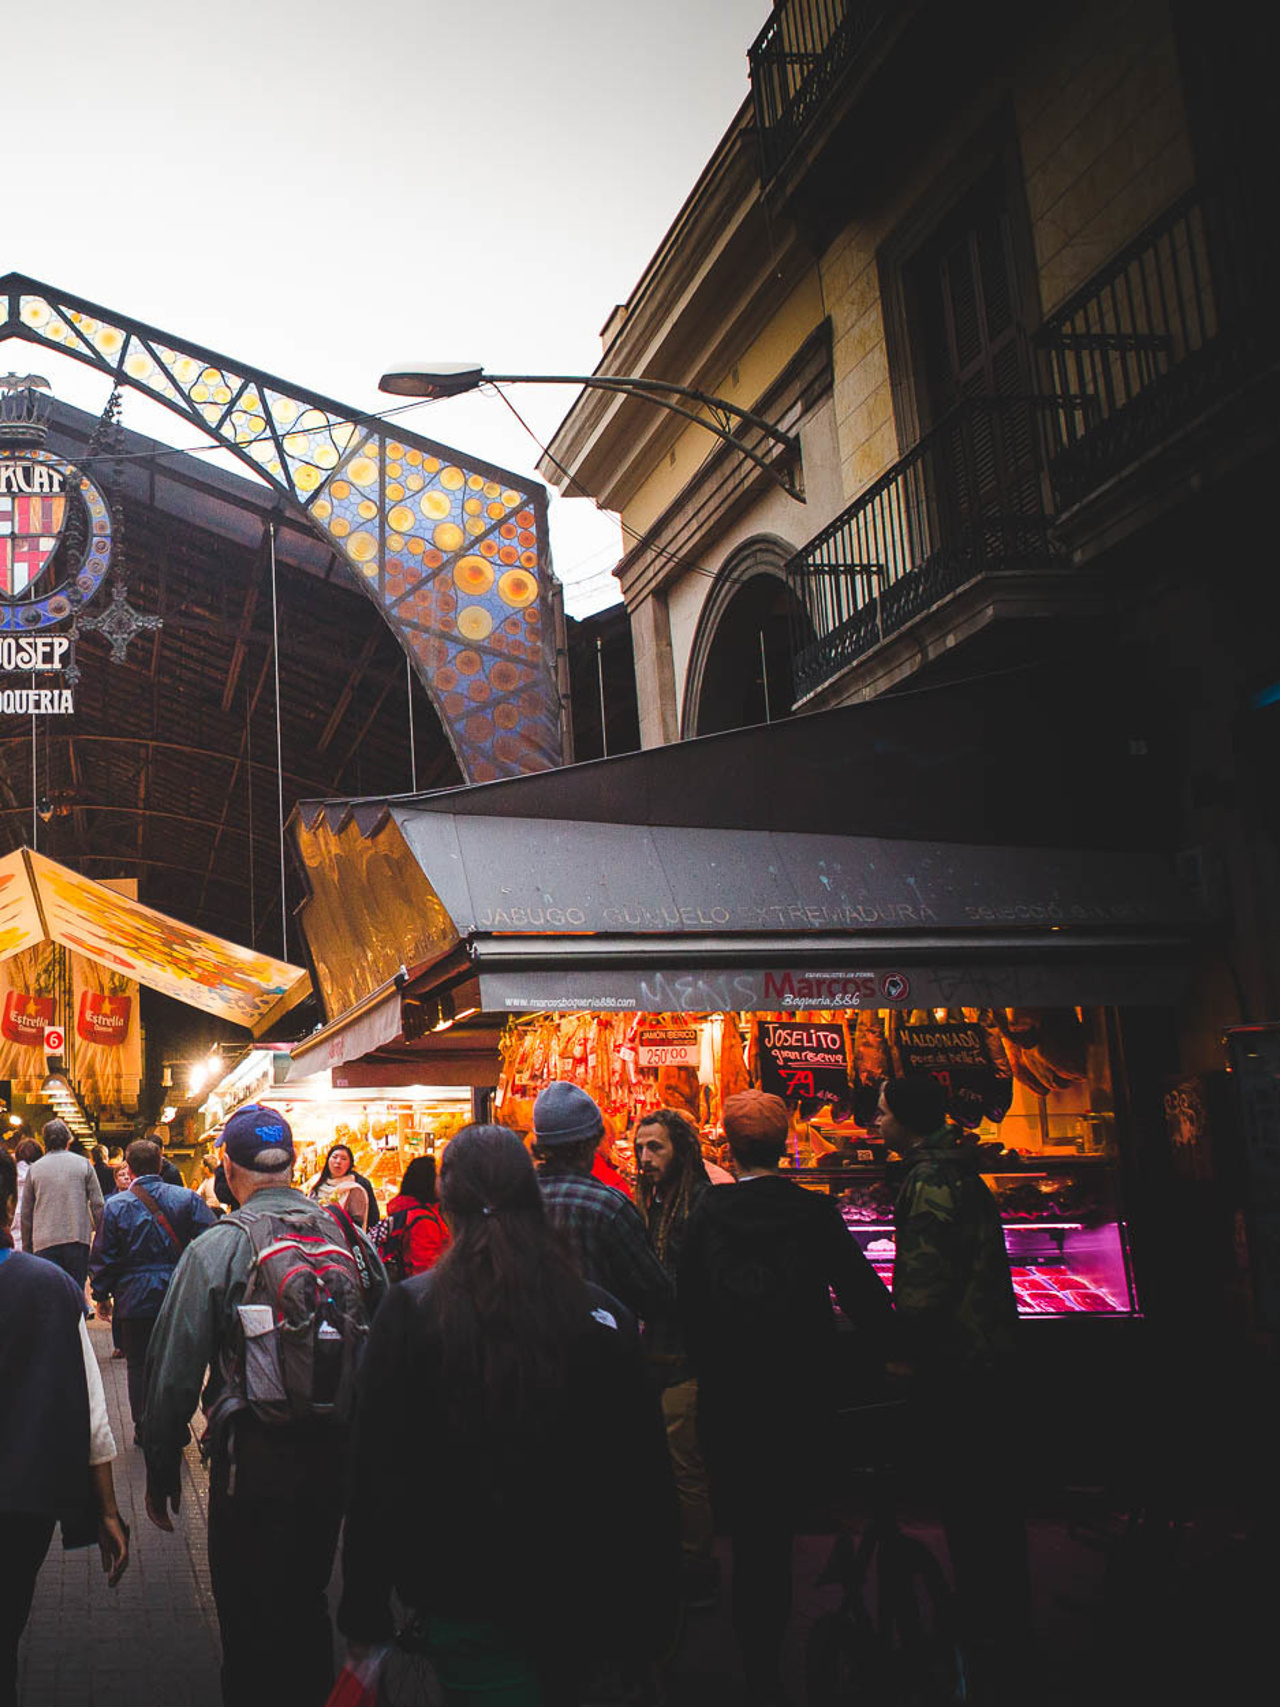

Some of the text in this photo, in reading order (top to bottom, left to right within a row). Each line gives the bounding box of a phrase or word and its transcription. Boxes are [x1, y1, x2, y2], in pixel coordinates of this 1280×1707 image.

[481, 907, 585, 926] JABUGO
[764, 972, 876, 999] Marcos
[9, 1010, 49, 1028] Estrella
[85, 1009, 124, 1027] Estrella
[49, 1033, 59, 1047] 6
